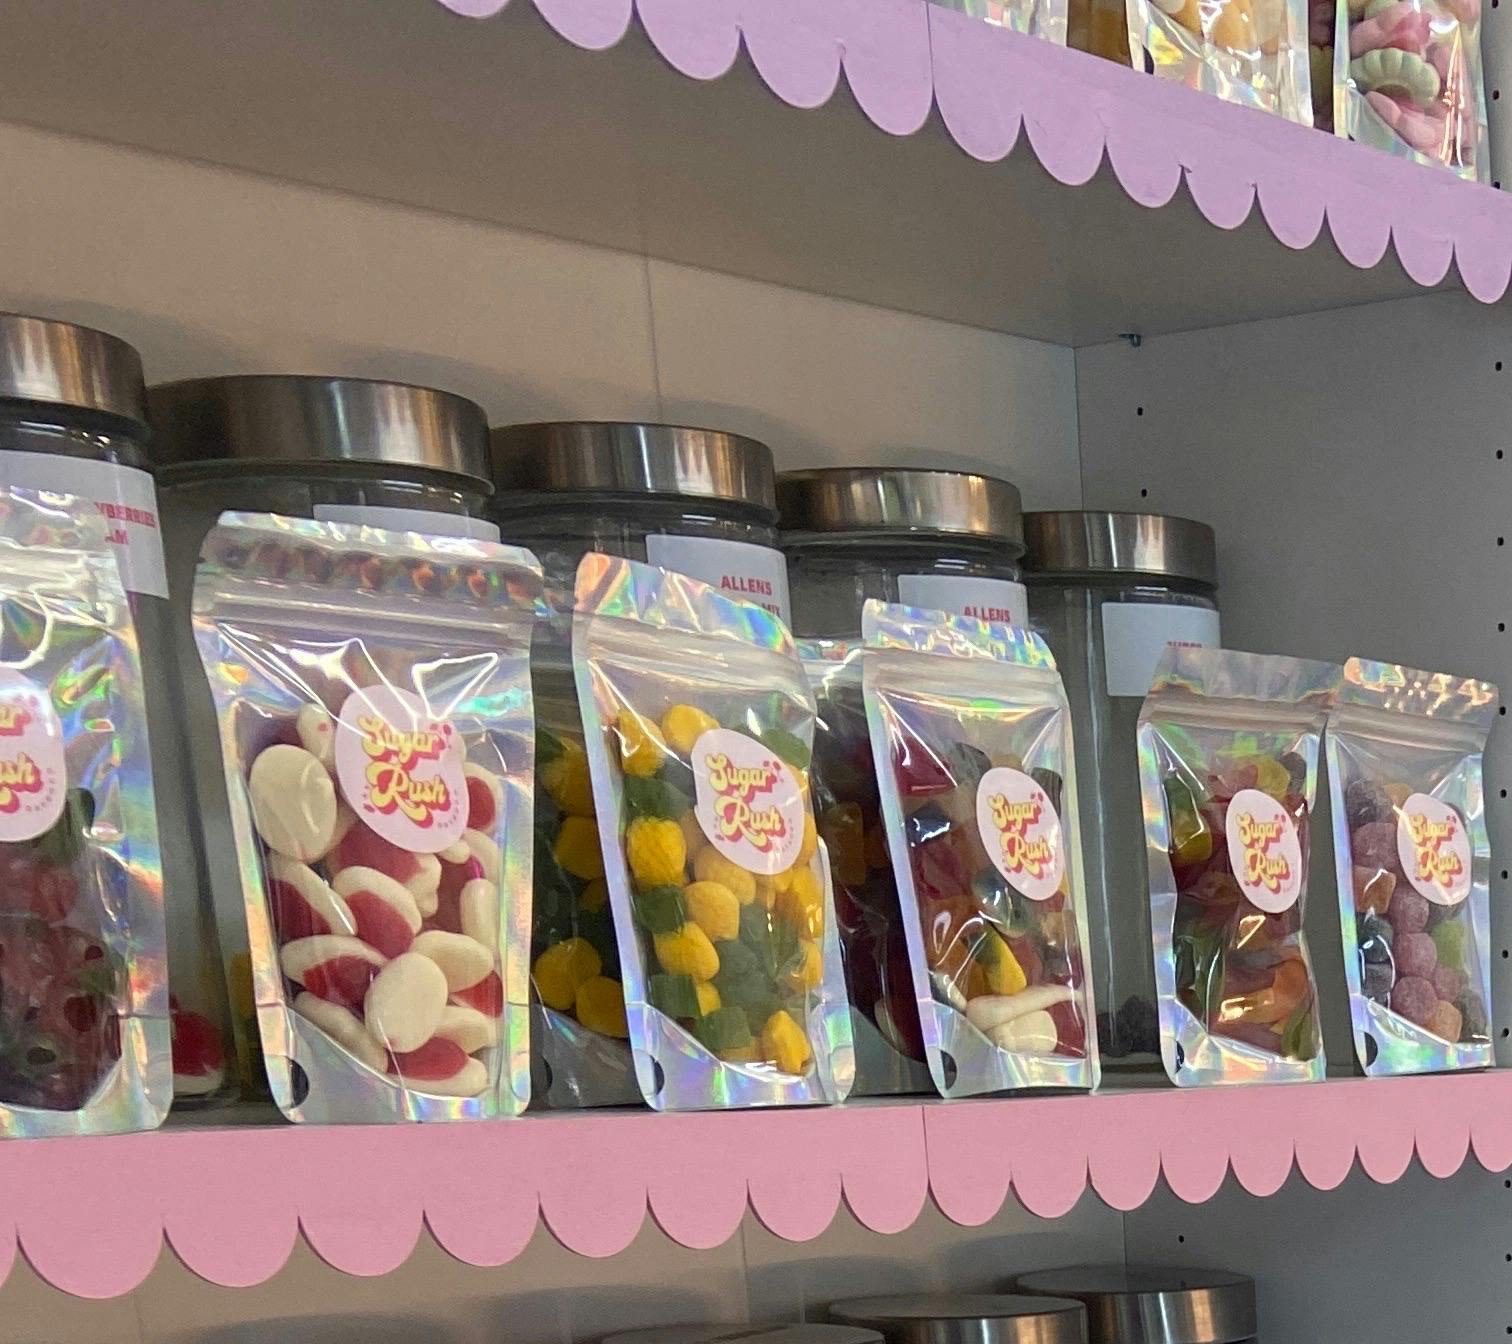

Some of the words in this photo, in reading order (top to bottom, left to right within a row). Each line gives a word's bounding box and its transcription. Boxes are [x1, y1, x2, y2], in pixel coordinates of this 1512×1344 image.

[721, 575, 772, 596] ALLENS
[963, 606, 1010, 623] ALLENS
[357, 714, 445, 770] Sugar
[366, 759, 450, 828] Rush
[705, 752, 777, 800] Sugar
[714, 796, 786, 852] Rush
[986, 792, 1042, 838] Sugar
[1235, 810, 1282, 851] Sugar
[999, 831, 1056, 880] Rush
[1242, 848, 1290, 894] Rush
